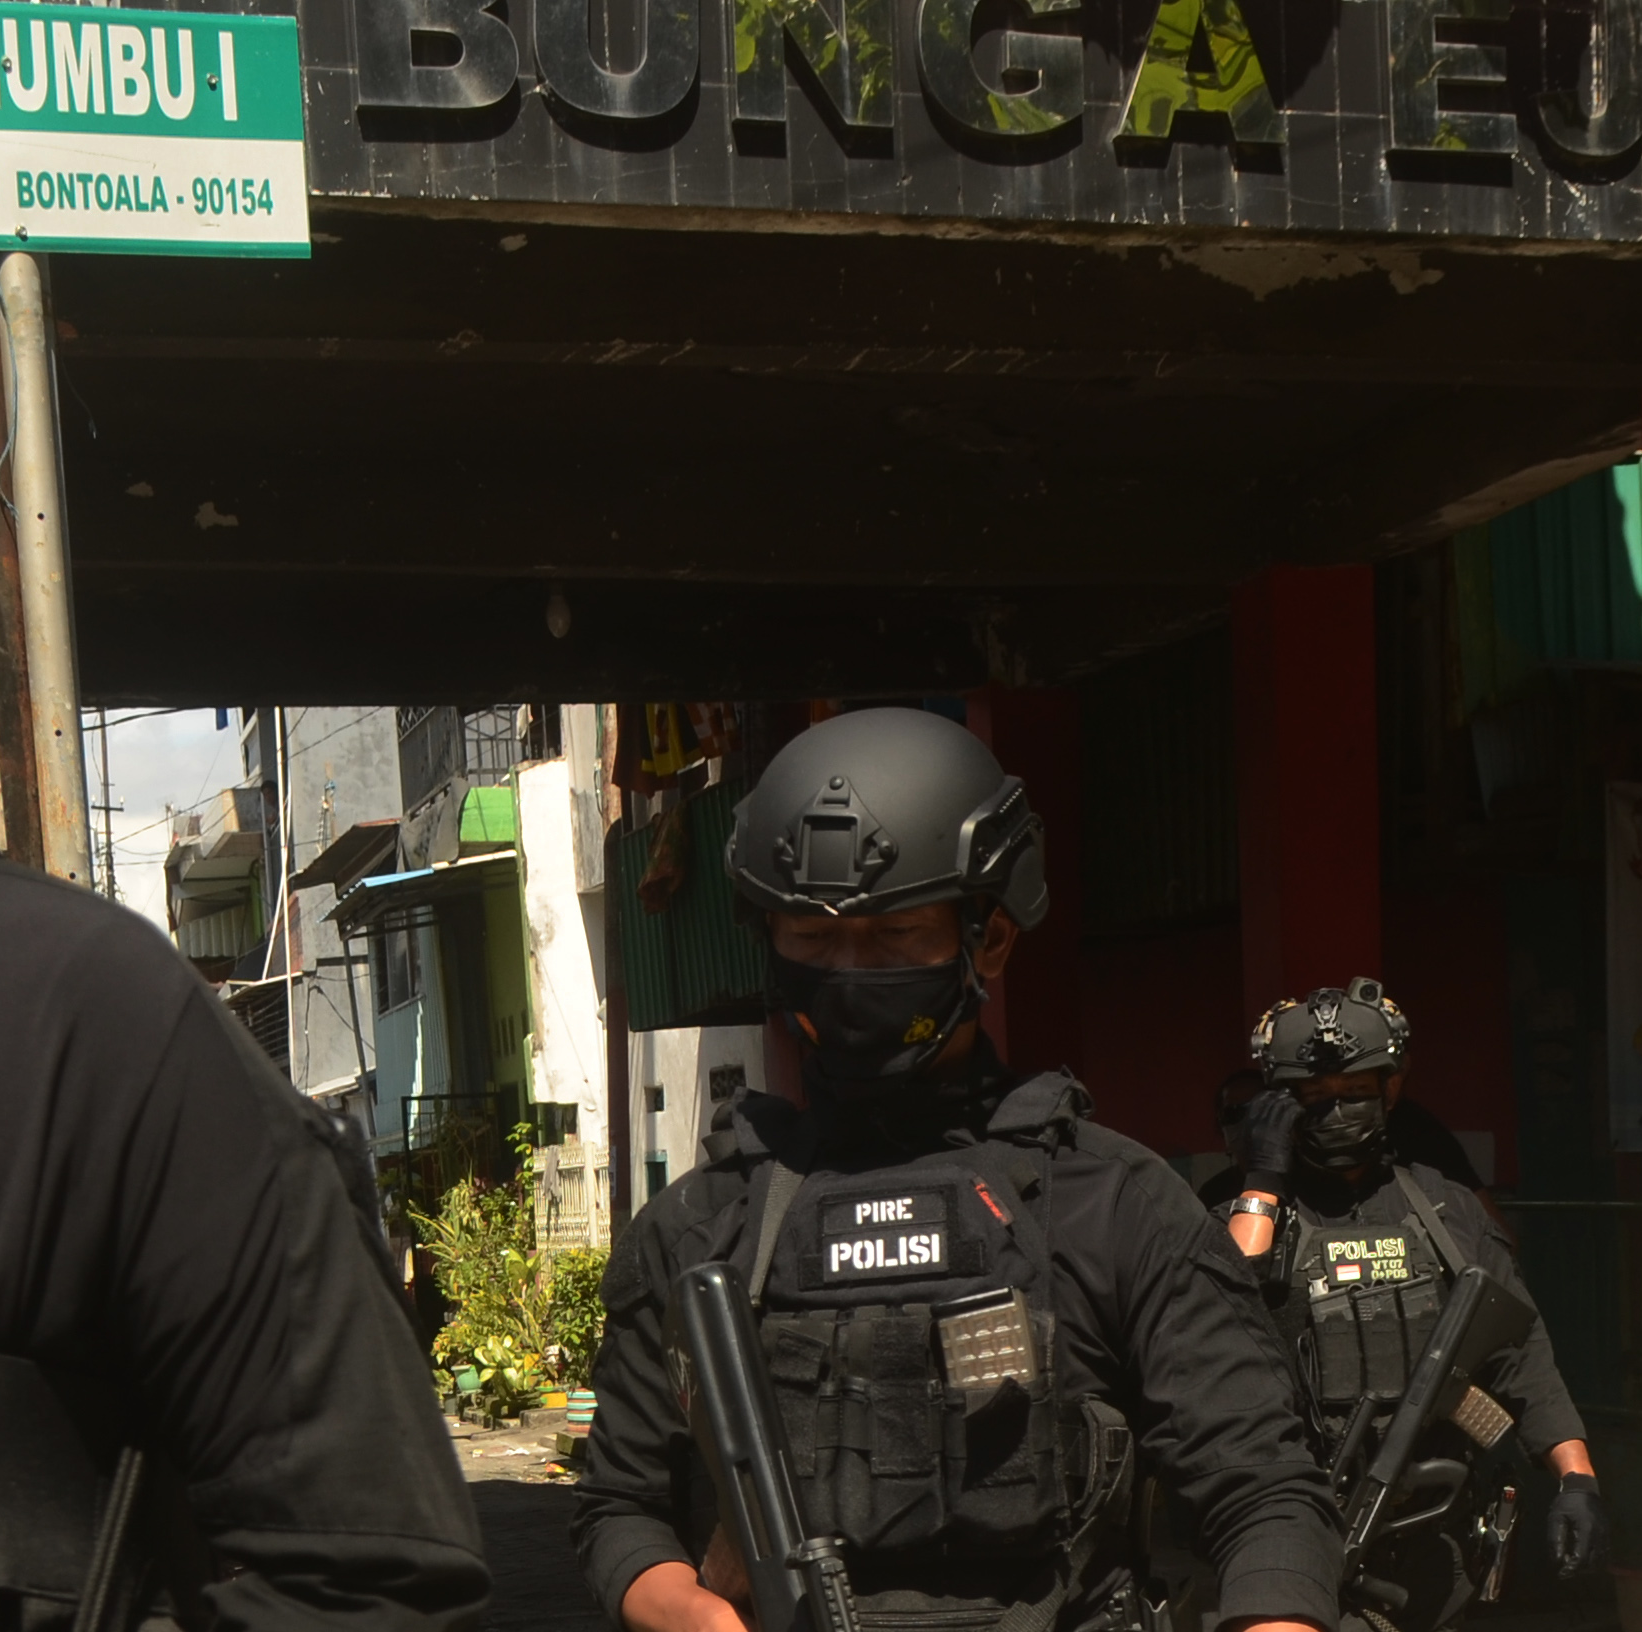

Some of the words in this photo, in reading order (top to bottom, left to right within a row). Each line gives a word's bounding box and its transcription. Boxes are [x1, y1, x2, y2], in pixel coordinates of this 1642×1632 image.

[218, 31, 238, 121] I
[16, 170, 169, 213] BONTOALA
[192, 177, 274, 216] 90154
[855, 1198, 913, 1224] PIRE
[830, 1233, 941, 1273] POLISI
[1327, 1237, 1406, 1262] POLISI
